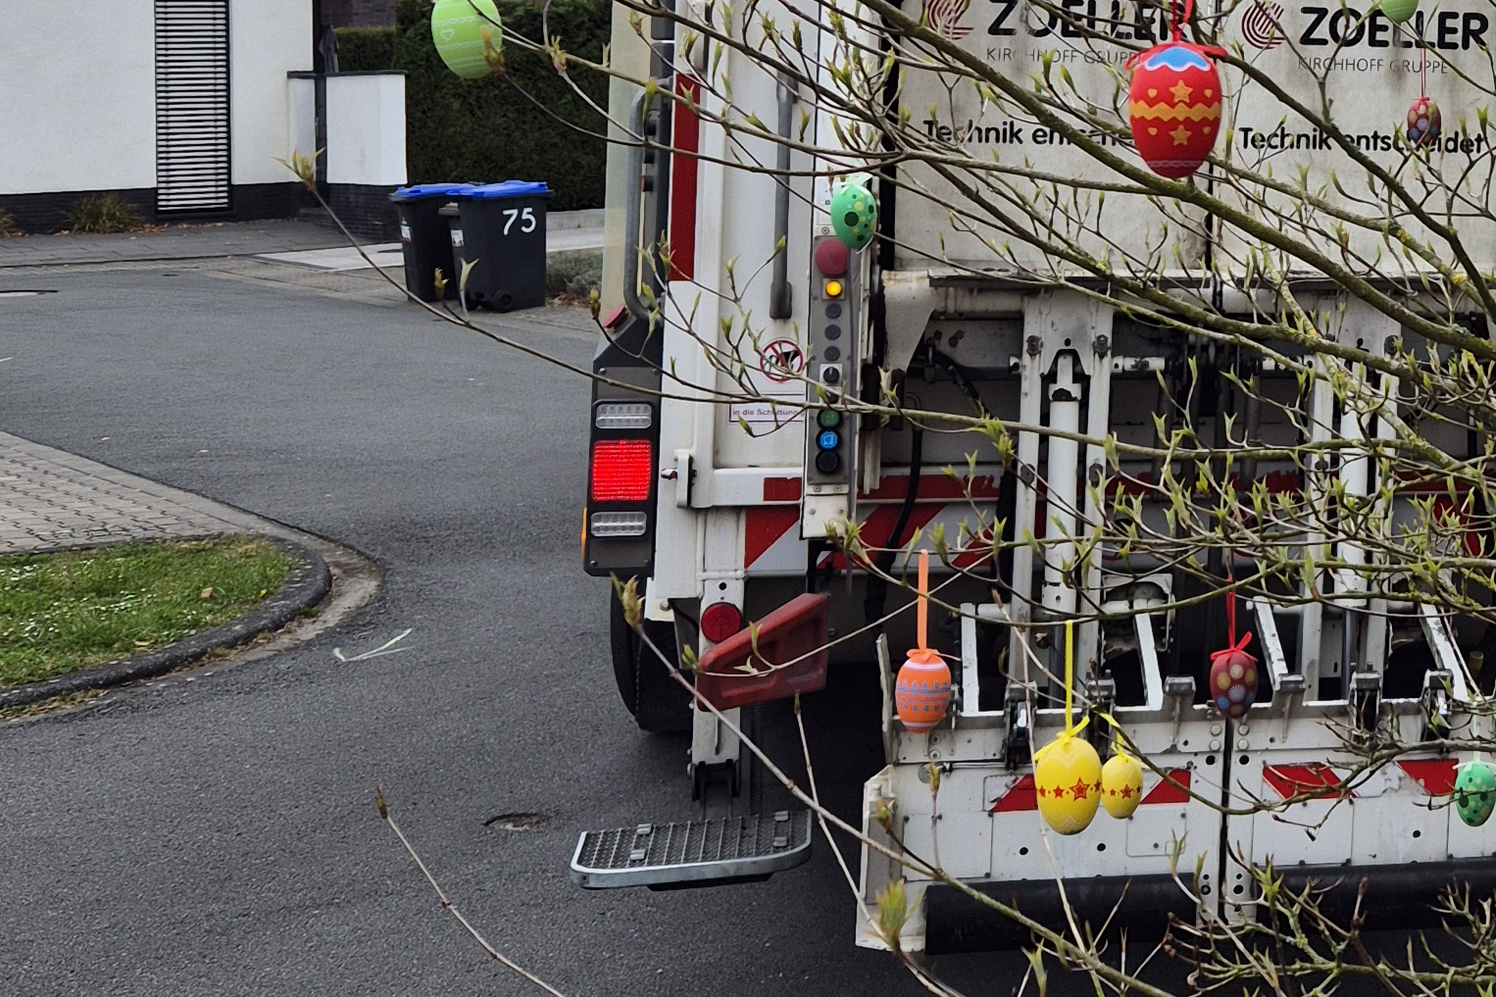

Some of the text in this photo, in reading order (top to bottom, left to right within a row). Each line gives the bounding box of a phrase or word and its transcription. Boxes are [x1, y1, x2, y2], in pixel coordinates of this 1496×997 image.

[1298, 57, 1385, 72] KIRCHHOFF
[1238, 126, 1333, 151] Technik
[502, 207, 537, 236] 75
